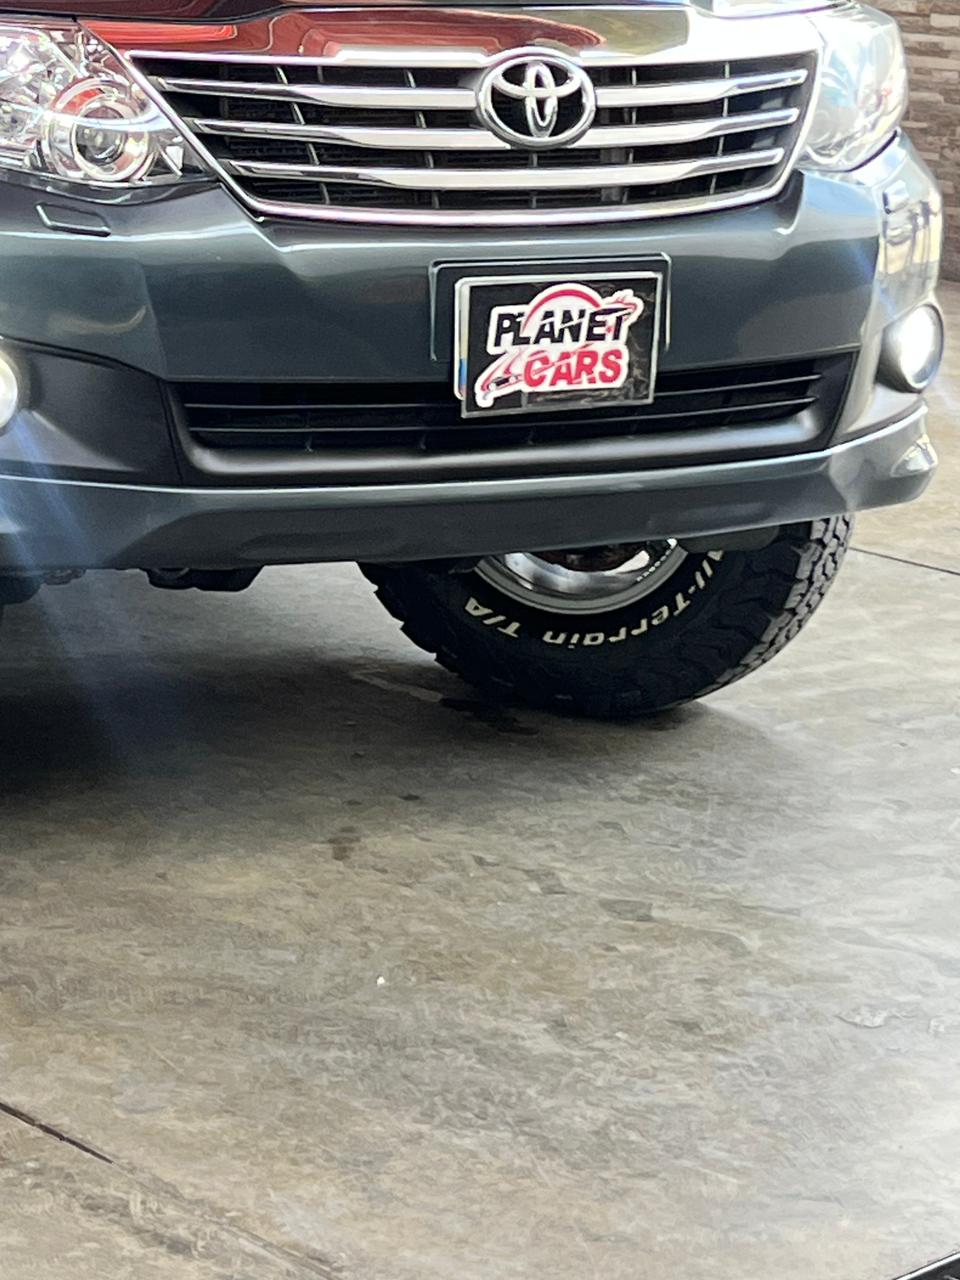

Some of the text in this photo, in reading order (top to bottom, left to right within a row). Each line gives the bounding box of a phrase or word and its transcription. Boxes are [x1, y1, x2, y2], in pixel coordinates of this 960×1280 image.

[493, 308, 628, 348] PLANET
[523, 348, 624, 388] CARS
[464, 597, 521, 638] T/A
